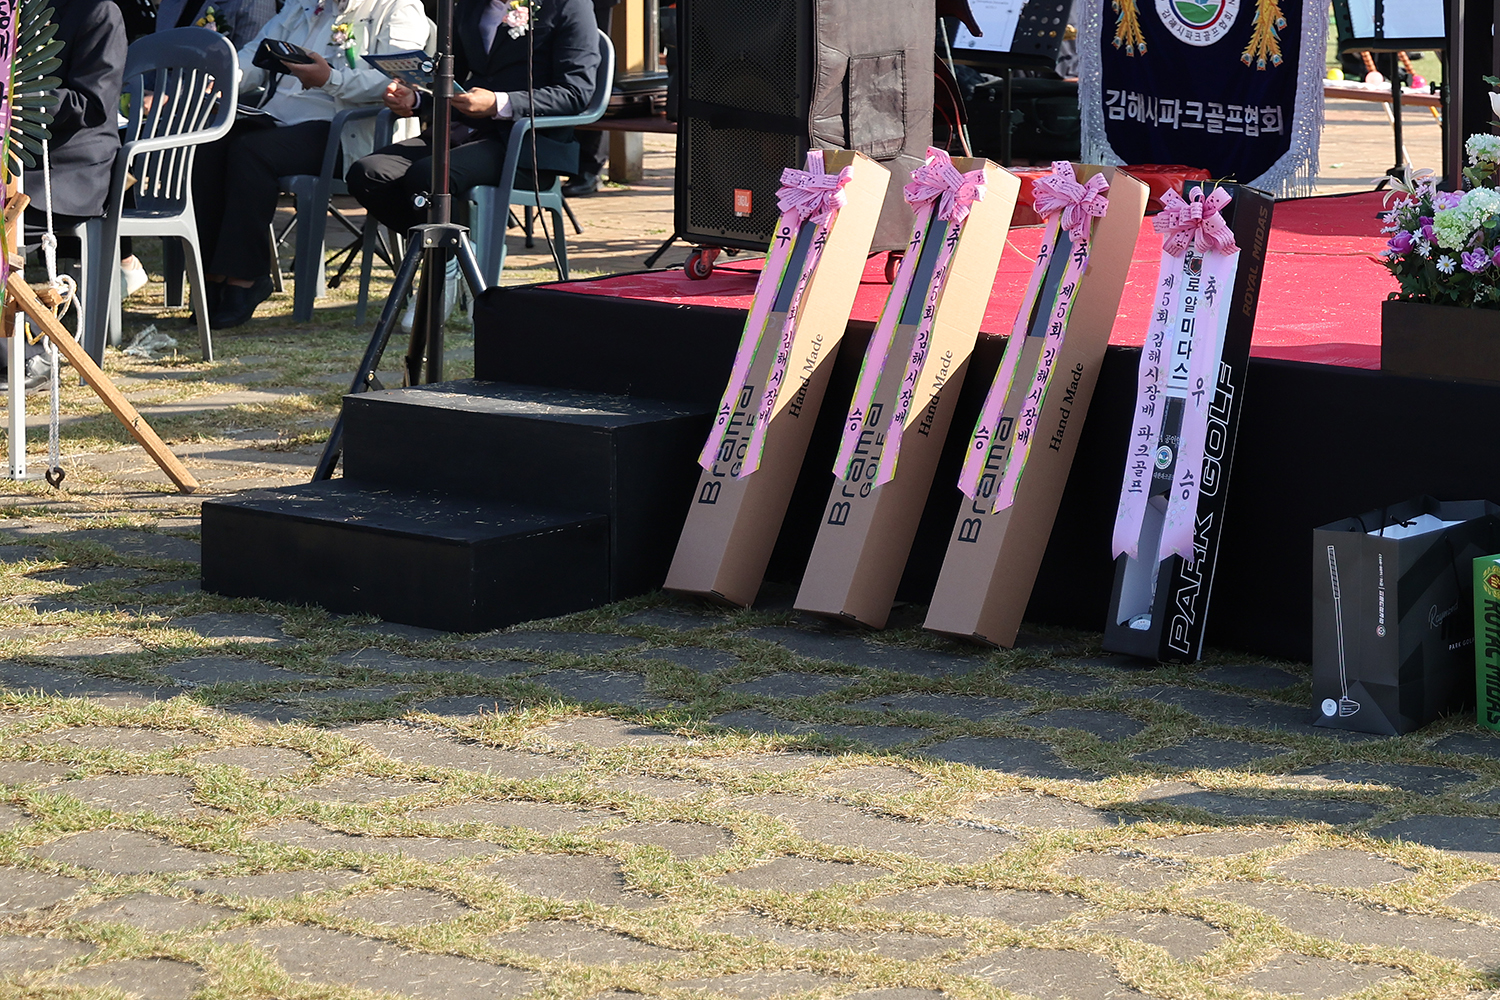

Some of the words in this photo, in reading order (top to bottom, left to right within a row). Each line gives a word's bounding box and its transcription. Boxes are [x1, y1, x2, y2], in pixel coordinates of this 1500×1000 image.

[1161, 8, 1234, 42] 김해시파크골프협회
[1105, 89, 1285, 137] 김해시파크골프협회
[776, 226, 792, 248] 우
[911, 230, 921, 252] 우
[1037, 243, 1047, 266] 우
[1242, 268, 1260, 318] ROYAL
[1255, 204, 1269, 265] MIDAS
[1049, 282, 1076, 341] 제5회
[1155, 274, 1175, 325] 제5회
[1172, 277, 1201, 381] 로얄미다스
[1203, 275, 1217, 308] 축
[788, 376, 811, 419] Hand
[802, 333, 824, 375] Made
[917, 393, 940, 437] Hand
[932, 349, 953, 393] Made
[1017, 349, 1054, 446] 김해시장배
[1049, 405, 1071, 453] Hand
[1063, 362, 1084, 405] Made
[1141, 332, 1165, 418] 김해시장배
[1191, 377, 1206, 408] 우
[701, 385, 754, 505] Brama
[827, 403, 884, 526] Brama
[957, 416, 1014, 543] Brama
[1127, 424, 1155, 494] 파크골프
[1169, 511, 1214, 655] PARK
[1200, 361, 1235, 498] GOLF
